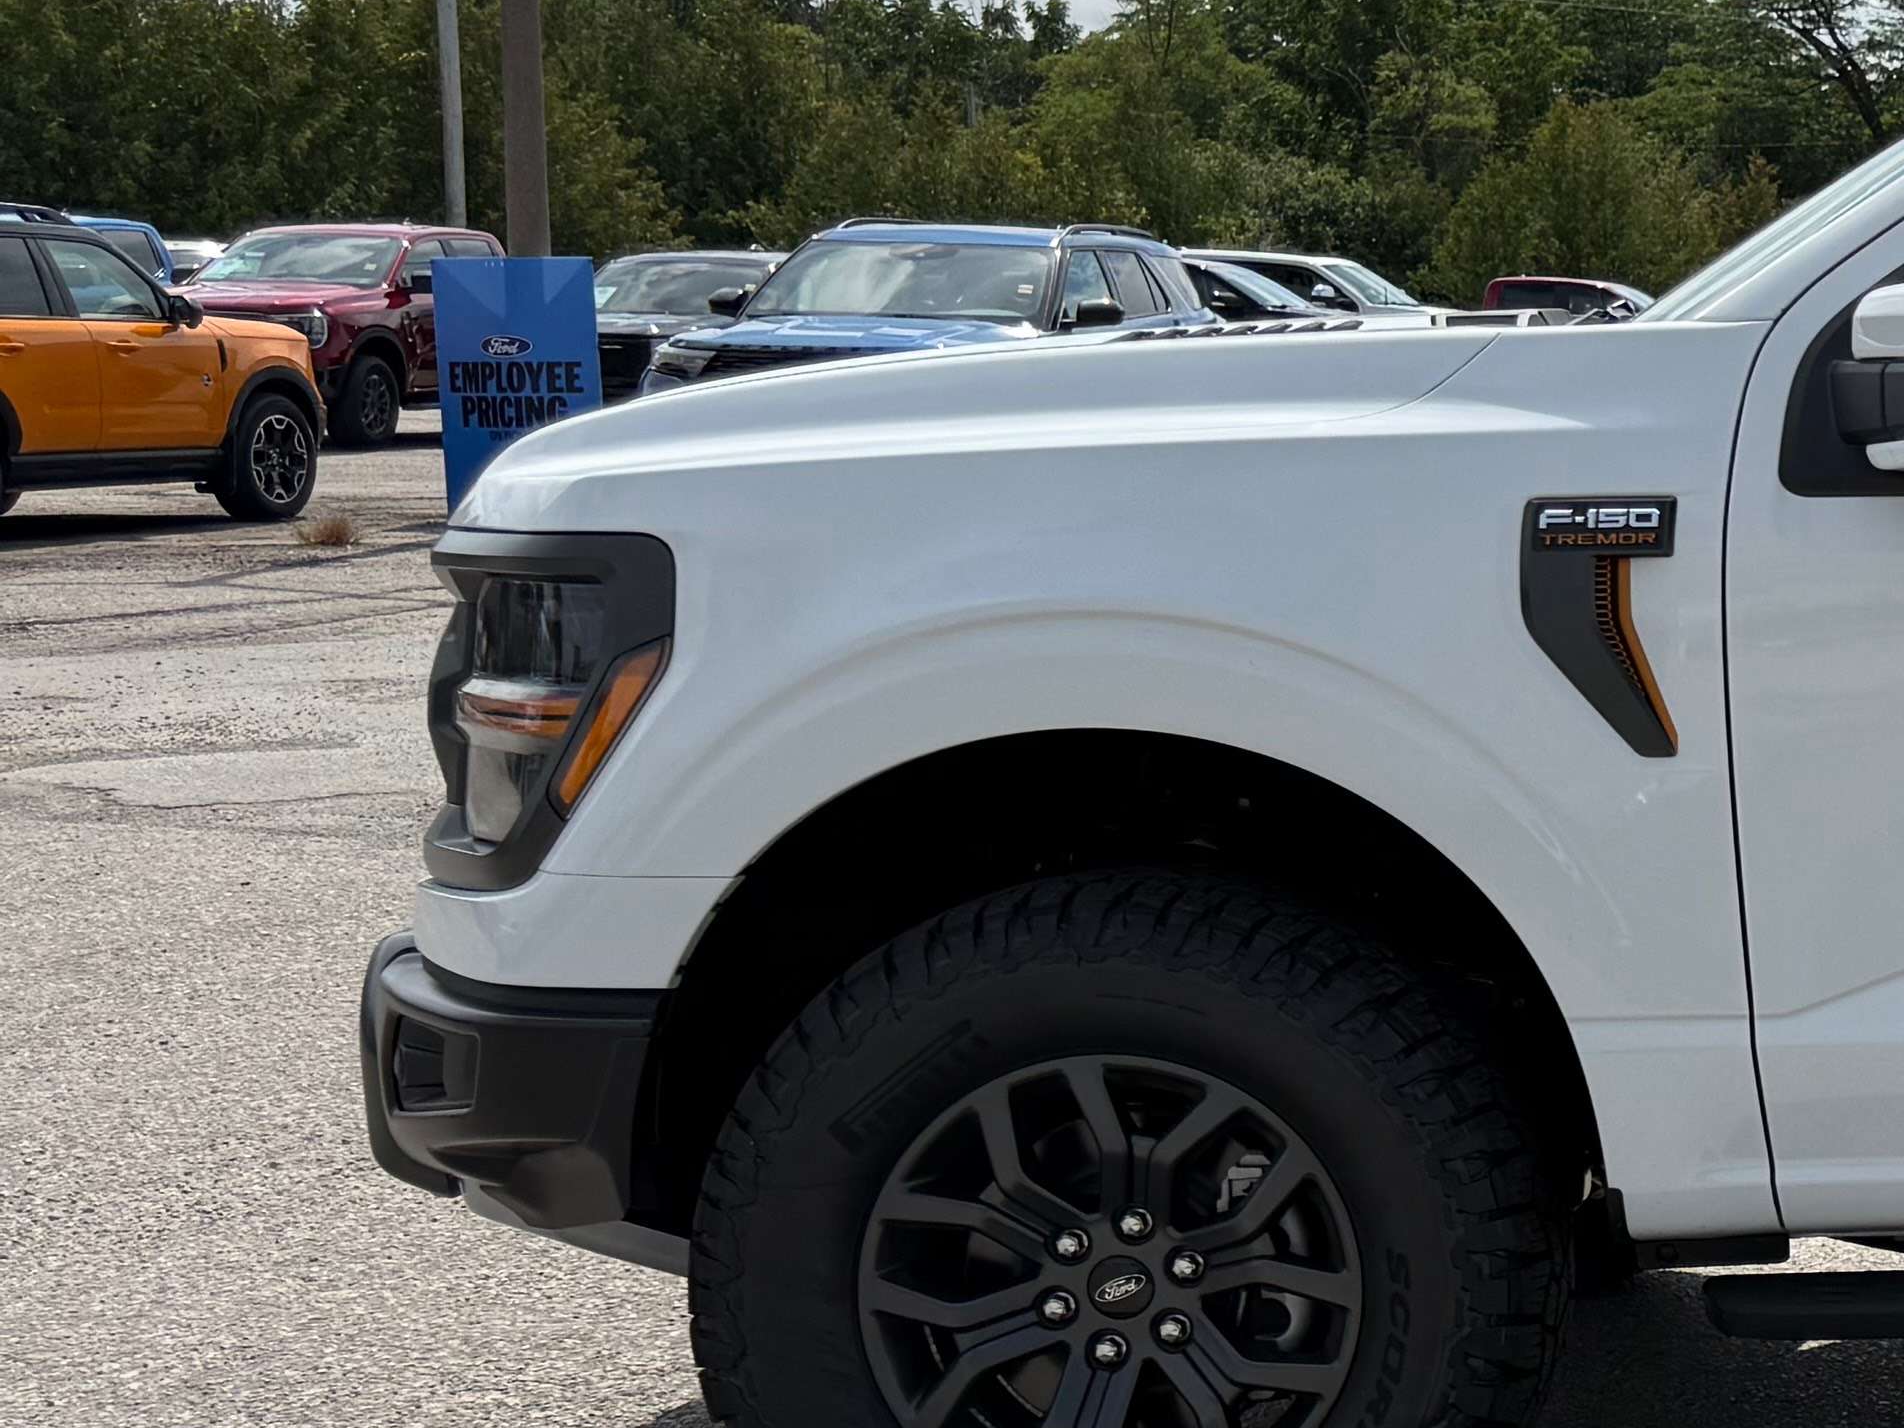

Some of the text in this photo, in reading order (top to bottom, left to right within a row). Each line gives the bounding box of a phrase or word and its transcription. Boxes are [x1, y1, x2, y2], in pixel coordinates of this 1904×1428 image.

[448, 362, 584, 394] EMPLOYEE
[461, 396, 568, 428] PRICING
[1538, 507, 1661, 529] F-150
[1541, 532, 1657, 546] TREMOR
